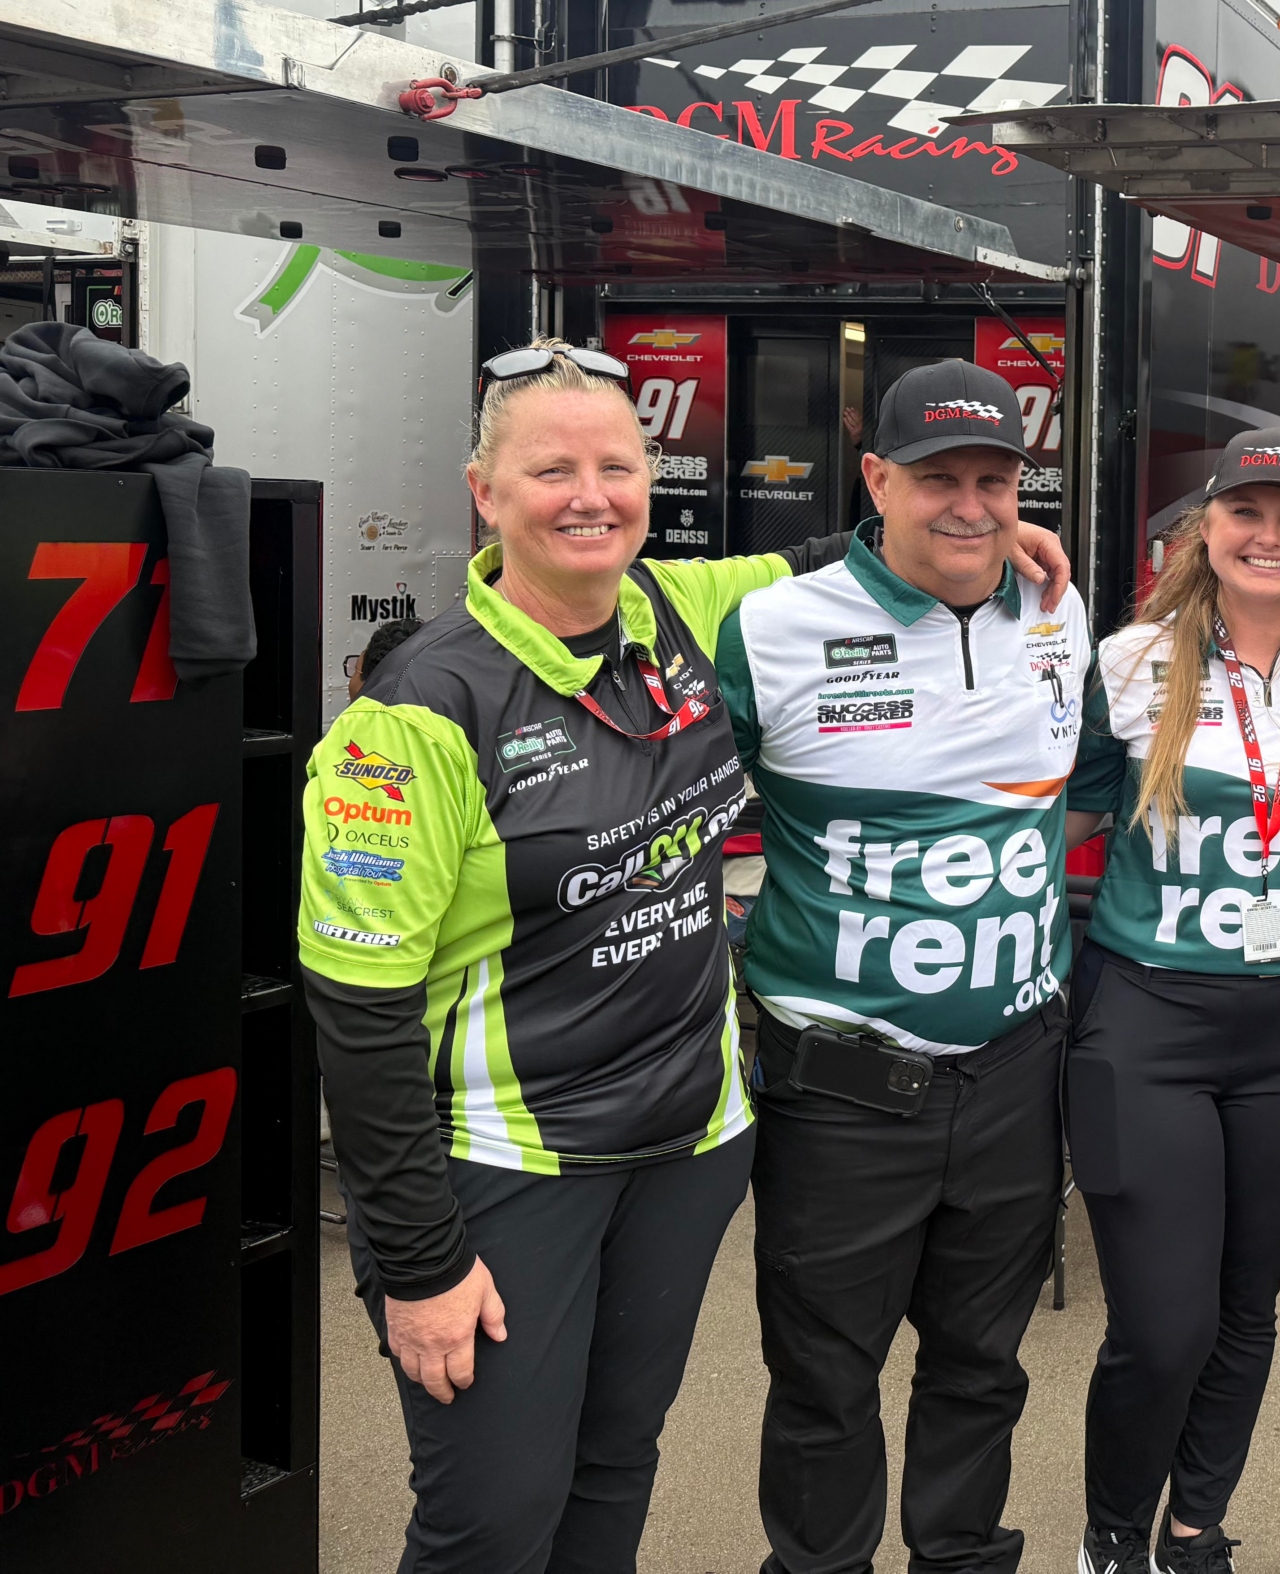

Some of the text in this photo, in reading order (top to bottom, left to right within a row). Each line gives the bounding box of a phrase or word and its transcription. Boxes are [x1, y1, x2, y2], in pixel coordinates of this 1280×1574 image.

[811, 119, 1019, 175] Racing
[95, 302, 123, 324] O'R
[627, 354, 703, 362] CHEVROLET
[635, 377, 701, 441] 91
[924, 407, 961, 422] DGM
[1240, 453, 1279, 467] DGM
[740, 489, 814, 501] CHEVROLET
[665, 529, 709, 544] DENSSI
[351, 594, 416, 622] Mystik
[15, 542, 177, 712] 71
[644, 673, 662, 690] 91
[826, 670, 900, 683] GOODYEAR
[1229, 671, 1243, 688] 92
[817, 688, 914, 700] investwithroots.com
[817, 699, 914, 715] SUCCESS
[817, 709, 914, 724] UNLOCKED
[546, 729, 562, 739] AUTO
[667, 715, 680, 736] 91
[503, 736, 567, 759] O'Reilly PARTS
[531, 752, 552, 762] SERIES
[340, 762, 411, 782] SUNOCO
[1249, 757, 1263, 773] 91
[508, 758, 589, 794] GOODYEAR
[587, 755, 740, 851] SAFETY IS IN YOUR HANDS
[1253, 784, 1266, 803] 92
[324, 796, 412, 826] Optum
[349, 852, 402, 867] Williams
[813, 819, 1047, 906] free
[326, 862, 363, 877] Hospital
[8, 802, 219, 998] 91
[336, 902, 395, 919] SEACREST
[669, 905, 712, 941] TIME.
[314, 920, 400, 946] MATRIX
[835, 882, 1060, 994] rent
[0, 1066, 237, 1296] 92
